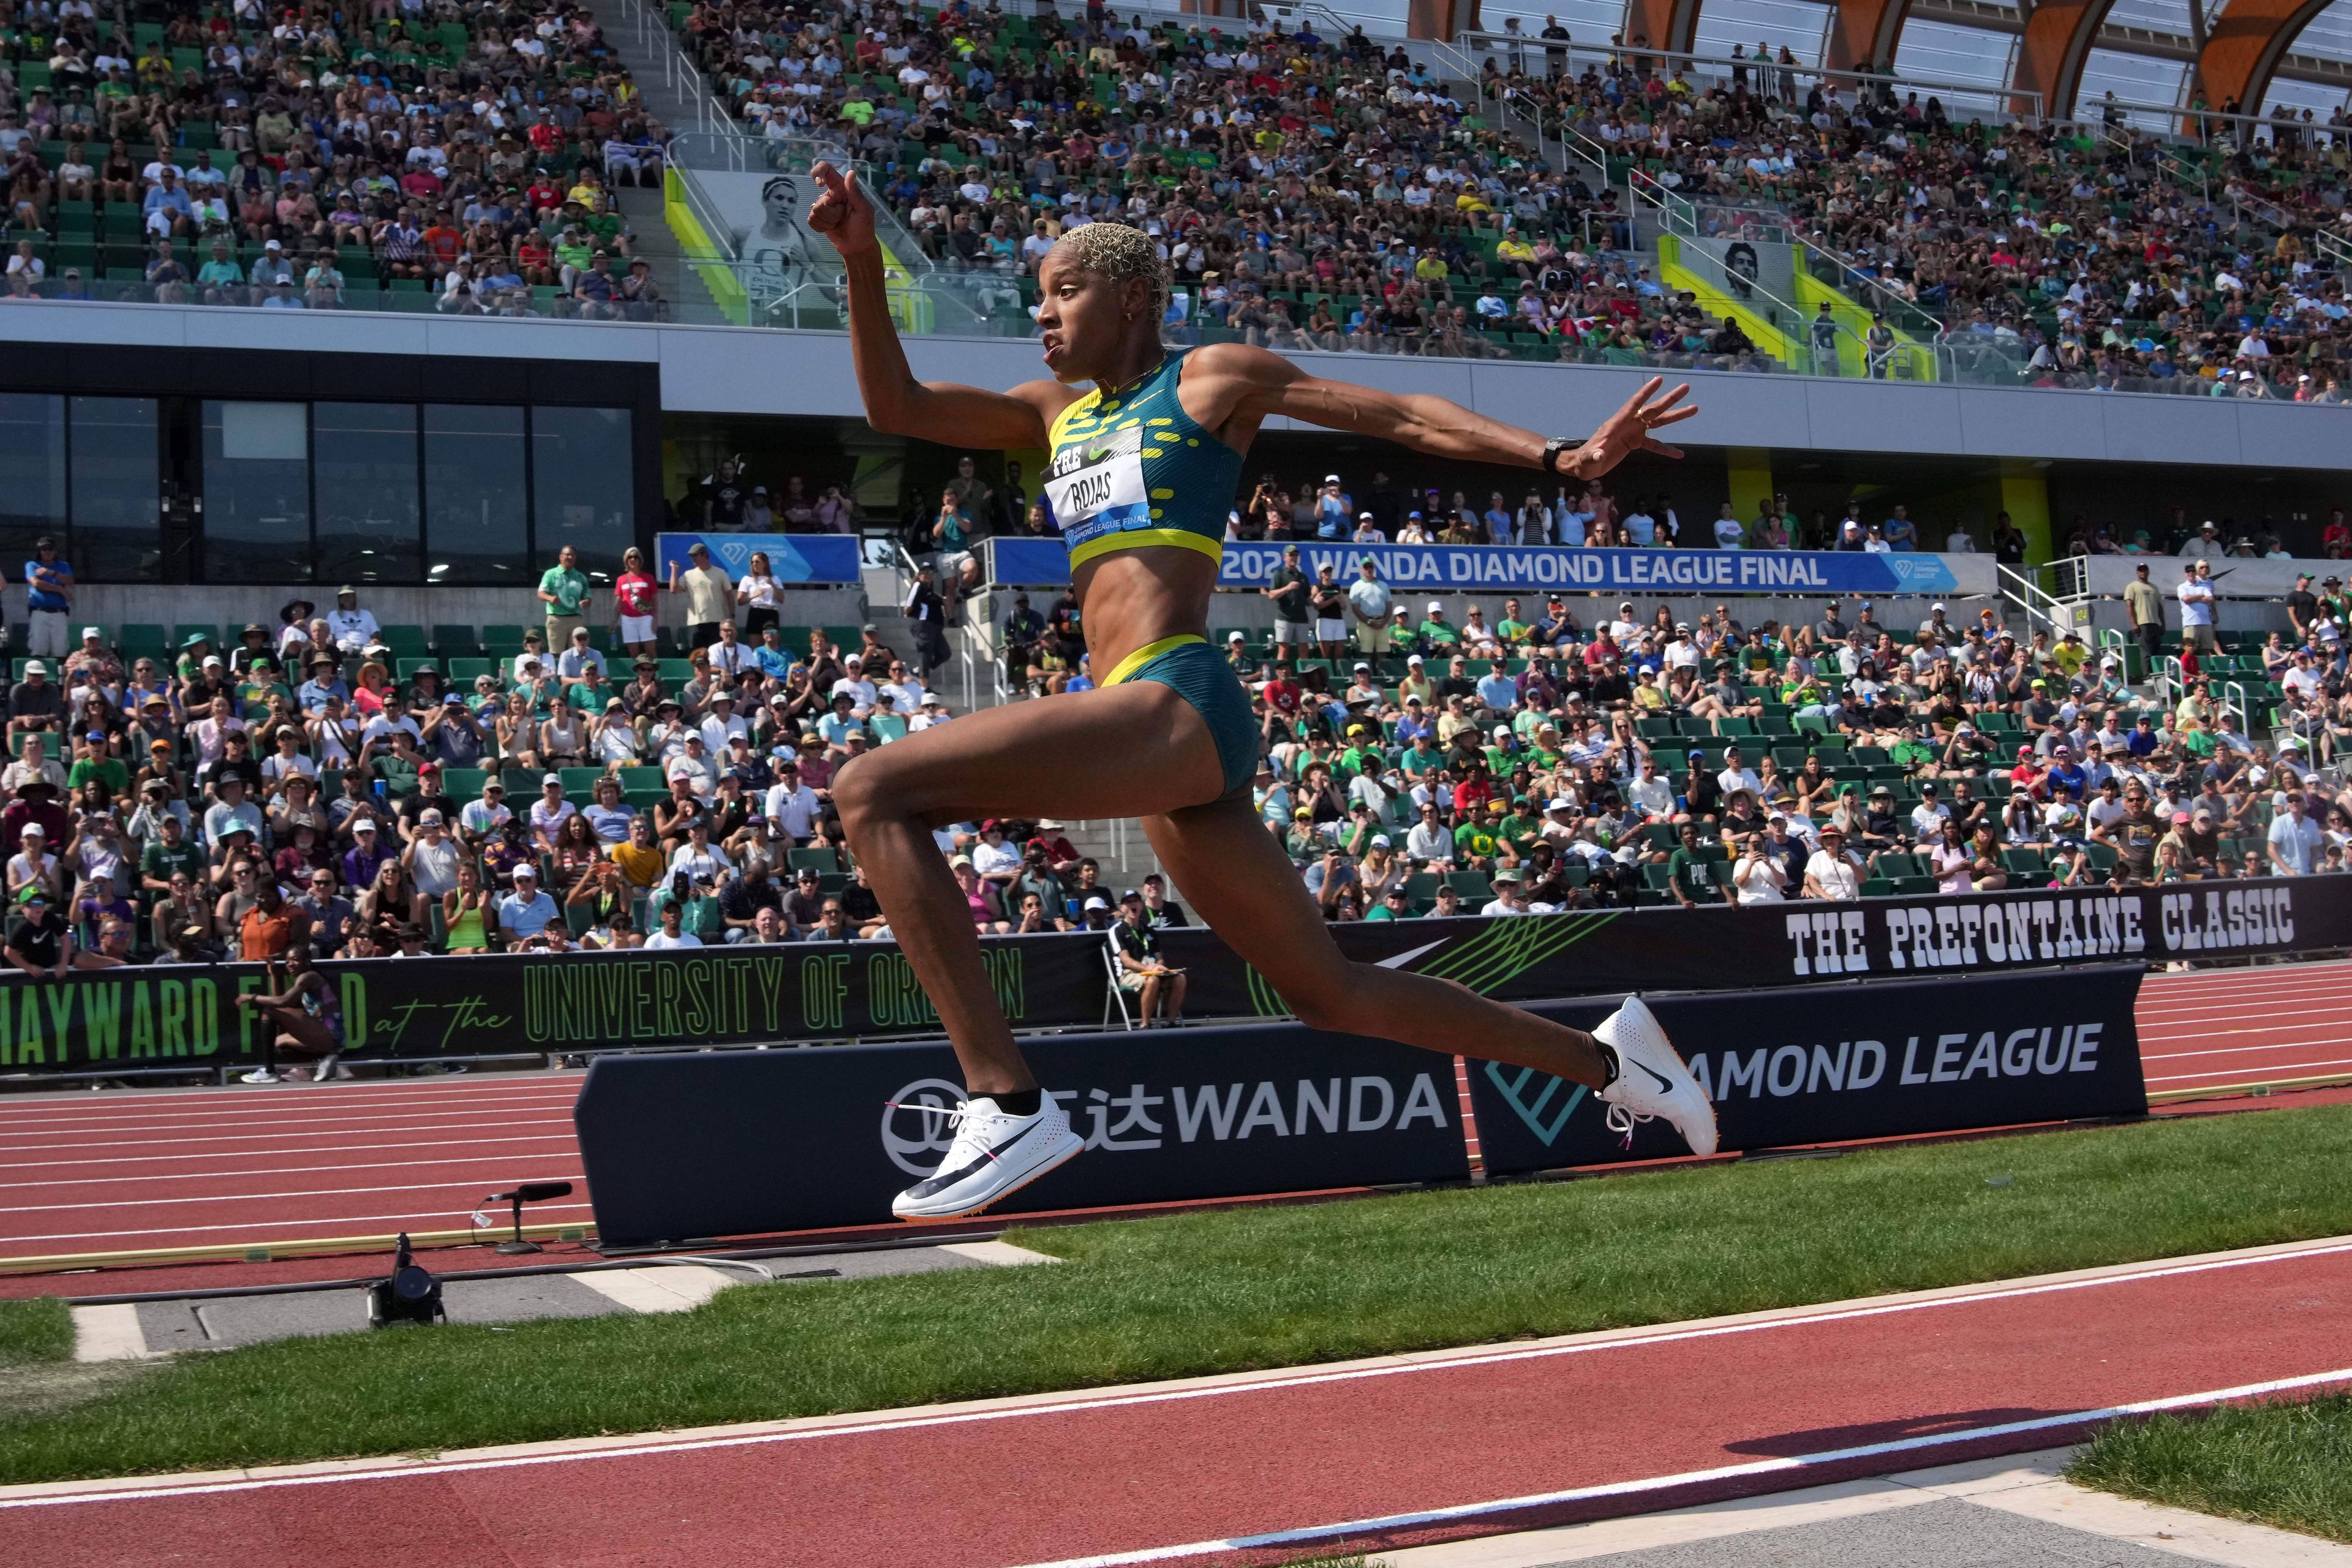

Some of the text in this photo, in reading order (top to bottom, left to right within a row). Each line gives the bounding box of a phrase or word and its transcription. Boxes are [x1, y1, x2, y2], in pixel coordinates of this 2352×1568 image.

[1054, 446, 1082, 477] PRE
[1071, 472, 1111, 511] ROJAS
[1074, 514, 1147, 541] DIAMOND LEAGUE FINAL
[1310, 551, 1442, 581] WANDA
[1449, 552, 1604, 583] DIAMOND
[1612, 556, 1733, 584] LEAGUE
[1741, 556, 1828, 586] FINAL
[1786, 888, 2294, 975] THE PREFONTAINE CLASSIC
[374, 998, 436, 1049] at
[442, 995, 512, 1048] the
[524, 957, 783, 1042] UNIVERSITY
[802, 954, 850, 1029] OF
[1900, 1022, 2103, 1085] LEAGUE
[1172, 1072, 1448, 1143] WANDA
